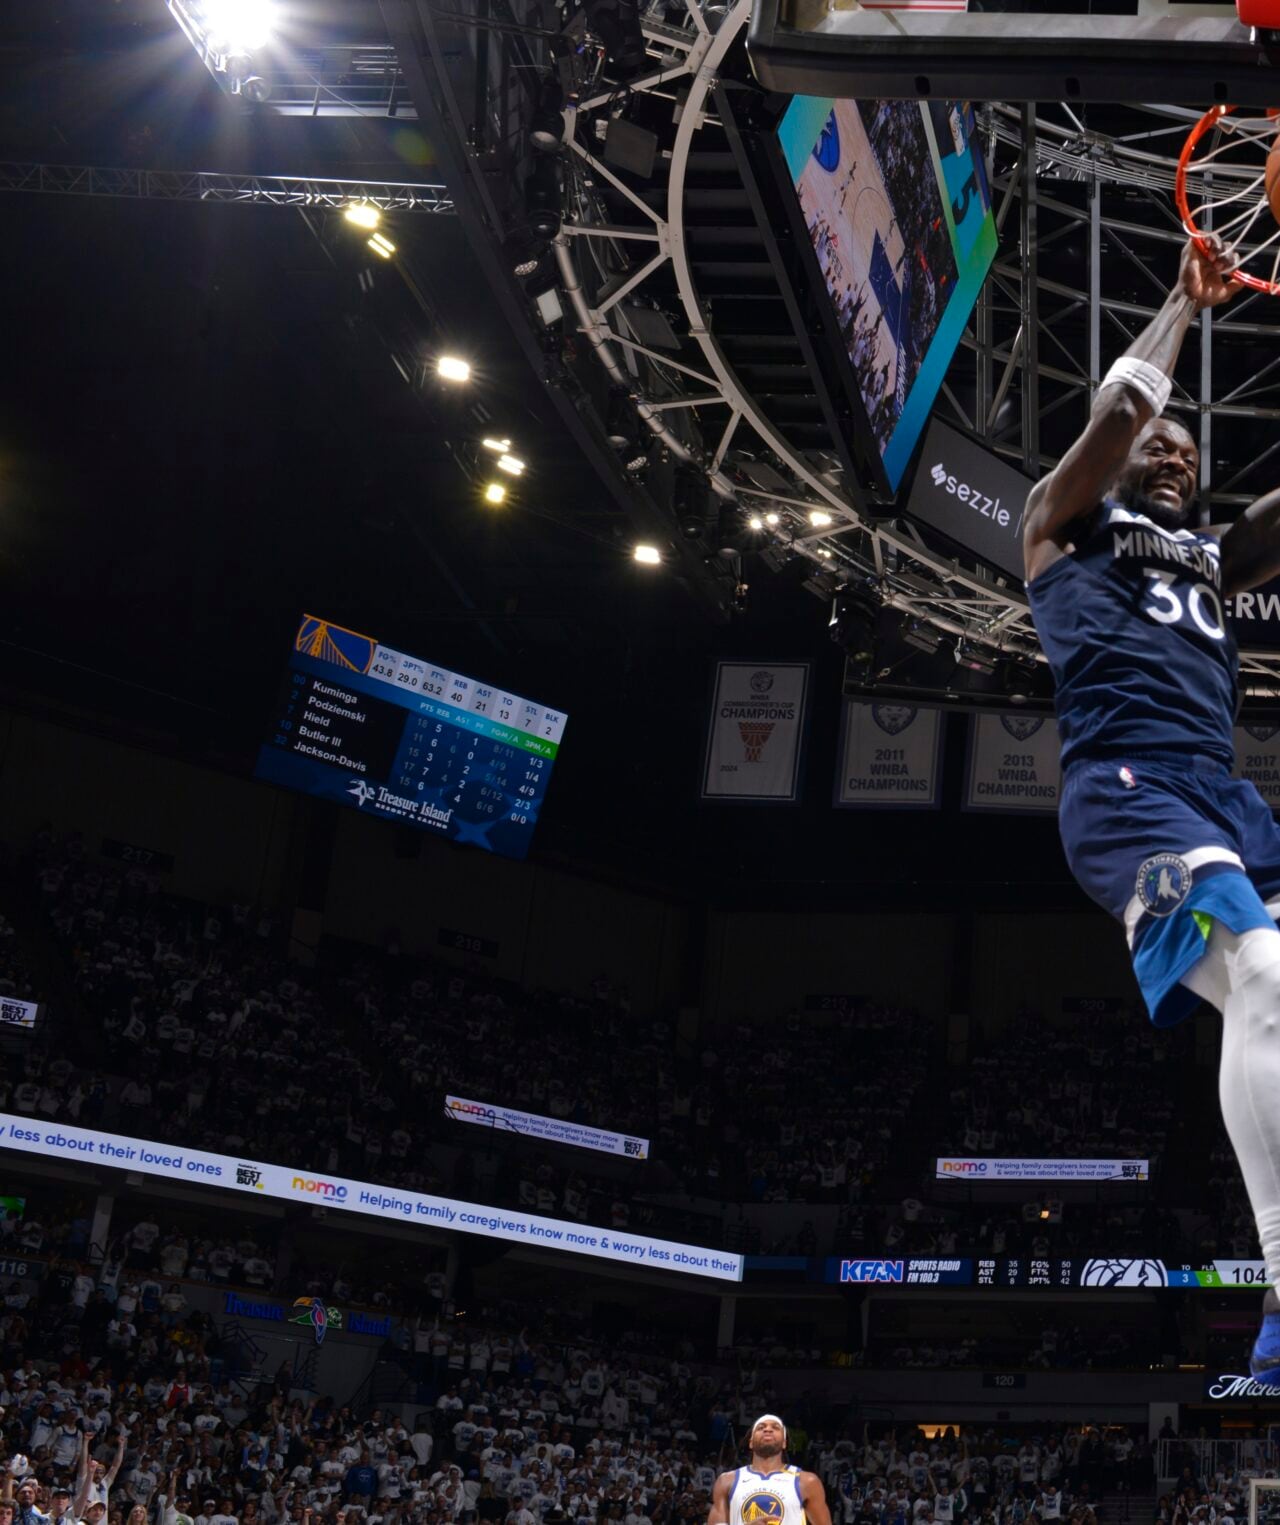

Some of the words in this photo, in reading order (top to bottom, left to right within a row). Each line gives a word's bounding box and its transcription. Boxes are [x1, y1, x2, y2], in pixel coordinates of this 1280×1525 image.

[944, 473, 1011, 528] sezzle
[1142, 567, 1226, 641] 30
[312, 680, 358, 705] Kuminga
[372, 664, 394, 678] 43.8
[397, 672, 418, 686] 29.0
[422, 681, 442, 696] 63.2
[451, 692, 463, 702] 40
[475, 701, 486, 711] 21
[499, 710, 510, 720] 13
[525, 719, 531, 728] 7
[545, 726, 552, 735] 2
[307, 695, 366, 723] Podziemski
[720, 708, 795, 720] CHAMPIONS
[303, 710, 331, 728] Hield
[298, 725, 331, 743] Butler
[331, 735, 342, 747] III
[293, 740, 367, 772] Jackson-Davis
[875, 749, 905, 762] 2011
[1002, 754, 1034, 767] 2013
[1245, 755, 1277, 768] 2017
[869, 763, 909, 776] WNBA
[997, 769, 1037, 782] WNBA
[1240, 769, 1280, 782] WNBA
[848, 778, 928, 791] CHAMPIONS
[976, 782, 1056, 798] CHAMPIONS
[377, 786, 419, 812] Treasure
[420, 800, 451, 823] Island
[1, 1004, 28, 1016] BEST
[1, 1011, 24, 1022] BUY
[10, 1125, 40, 1142] less
[45, 1134, 95, 1152] about
[99, 1142, 137, 1160] their
[140, 1148, 183, 1169] loved
[186, 1160, 223, 1176] ones
[623, 1140, 643, 1151] BEST
[943, 1162, 987, 1172] nomo
[236, 1168, 262, 1181] BEST
[236, 1176, 258, 1187] BUY
[291, 1176, 348, 1198] nomo
[360, 1190, 412, 1215] Helping
[416, 1201, 457, 1222] family
[459, 1213, 527, 1233] caregivers
[530, 1223, 564, 1240] know
[566, 1233, 597, 1247] more
[600, 1237, 610, 1250] &
[613, 1242, 647, 1259] worry
[649, 1246, 671, 1261] less
[673, 1252, 709, 1268] about
[711, 1258, 738, 1273] their
[840, 1259, 904, 1283] KFAN
[908, 1260, 938, 1271] SPORTS
[938, 1260, 961, 1271] RADIO
[978, 1260, 996, 1268] REB
[1008, 1260, 1018, 1268] 35
[1031, 1260, 1050, 1269] FG%
[907, 1273, 919, 1283] FM
[919, 1272, 940, 1283] 100.3
[978, 1268, 994, 1276] AST
[1008, 1268, 1018, 1276] 29
[1031, 1268, 1049, 1276] FT%
[1061, 1268, 1071, 1276] 61
[1182, 1273, 1189, 1283] 3
[1206, 1274, 1213, 1283] 3
[1231, 1267, 1267, 1285] 104
[978, 1276, 994, 1284] STL
[1009, 1277, 1015, 1285] 8
[1028, 1276, 1050, 1285] 3PT%
[1060, 1277, 1070, 1285] 42
[994, 1375, 1015, 1387] 120
[768, 1501, 777, 1514] 7
